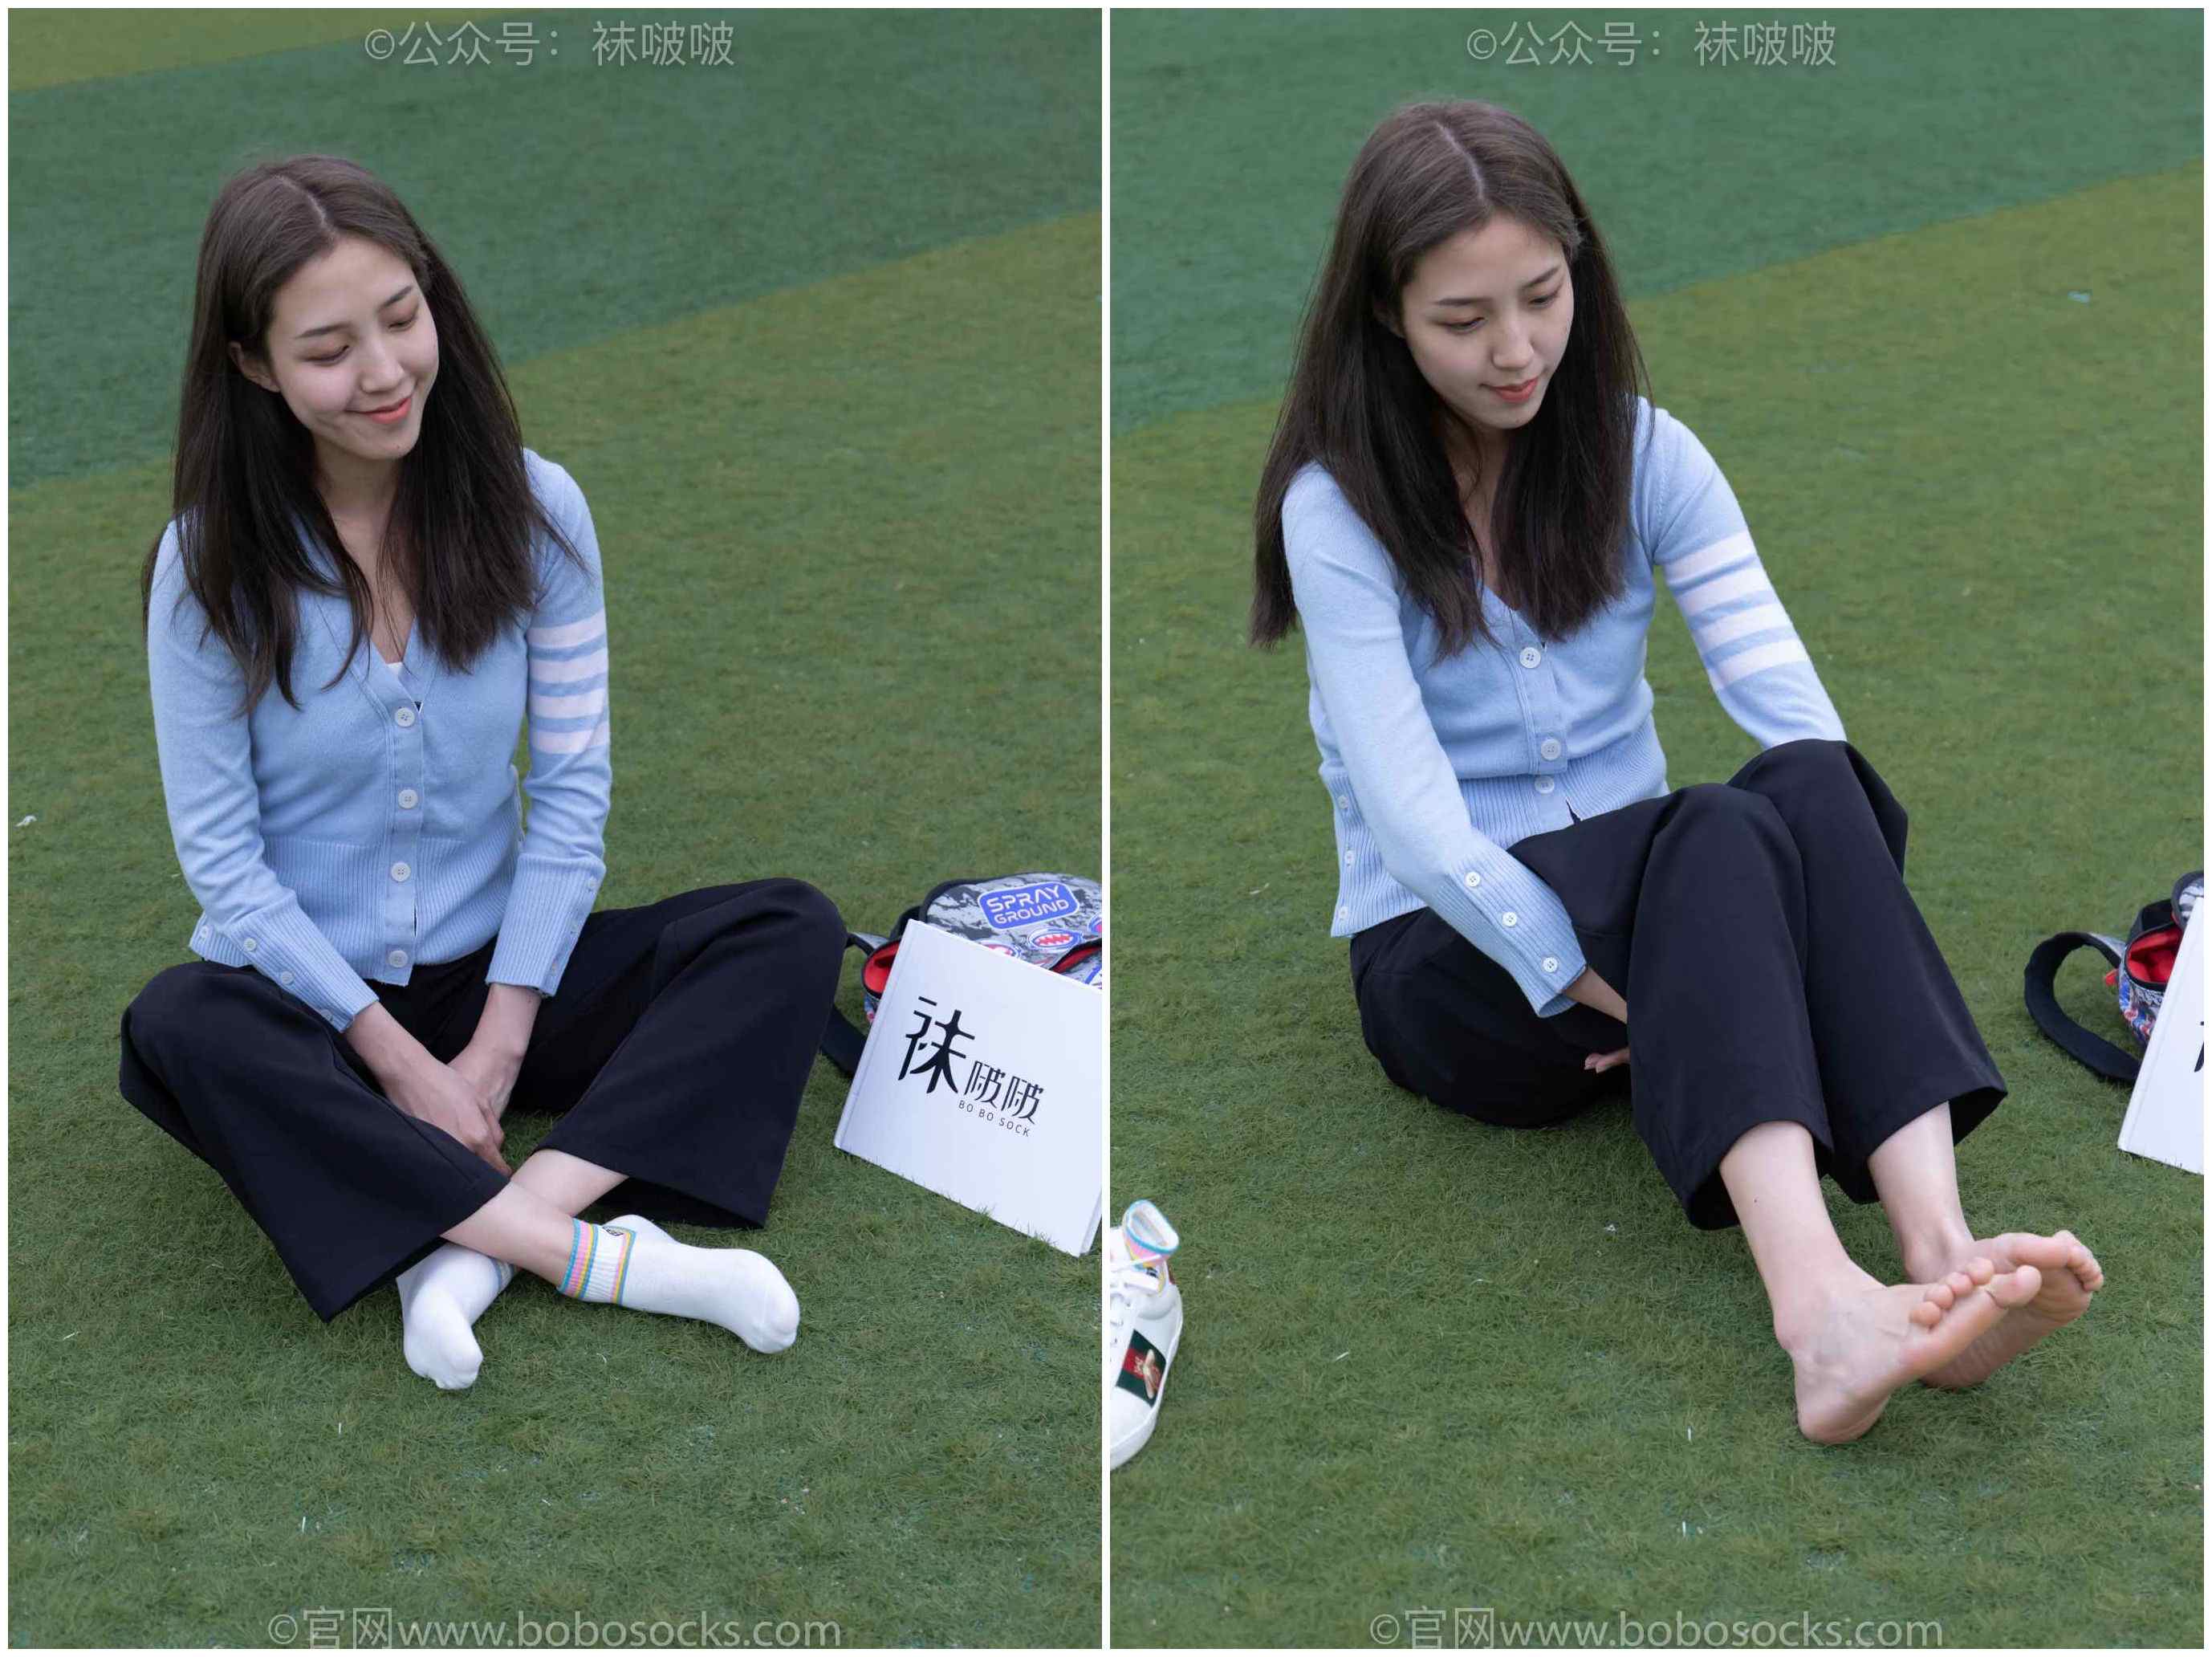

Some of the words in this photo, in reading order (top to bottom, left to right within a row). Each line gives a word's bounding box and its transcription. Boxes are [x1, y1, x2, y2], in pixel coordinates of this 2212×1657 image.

[986, 885, 1060, 913] SPRAY
[994, 899, 1069, 924] GROUND
[958, 1100, 974, 1113] BO
[978, 1109, 994, 1122] BO
[998, 1118, 1031, 1137] SOCK
